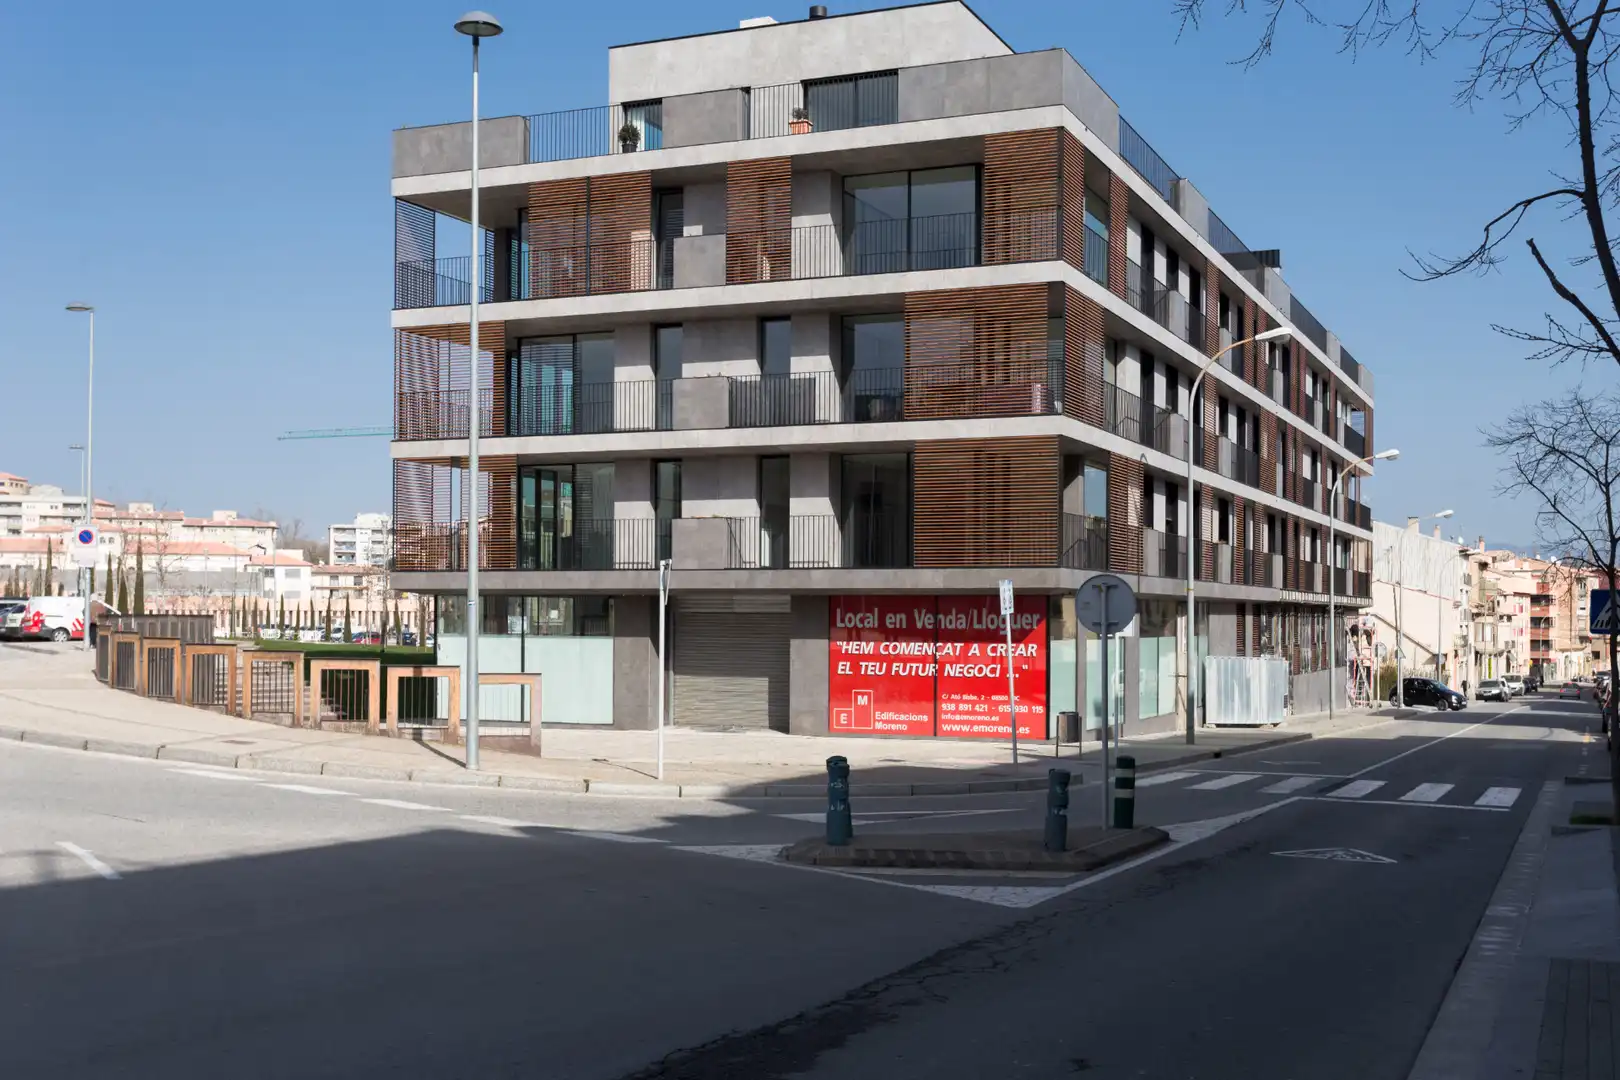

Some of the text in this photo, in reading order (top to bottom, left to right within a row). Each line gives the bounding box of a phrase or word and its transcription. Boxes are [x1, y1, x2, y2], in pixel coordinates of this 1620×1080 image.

[836, 607, 1040, 635] Local en Venda/Lloguer
[880, 642, 964, 659] COMENÇAT
[968, 644, 980, 656] A
[987, 644, 1038, 657] CREAR
[838, 662, 854, 674] EL
[860, 662, 887, 675] TEU
[892, 662, 938, 676] FUTUR
[944, 664, 1000, 678] NEGOCI
[857, 695, 868, 705] M
[998, 704, 1012, 712] 615
[840, 713, 848, 724] E
[875, 712, 928, 722] Edificacions
[874, 722, 908, 730] Moreno
